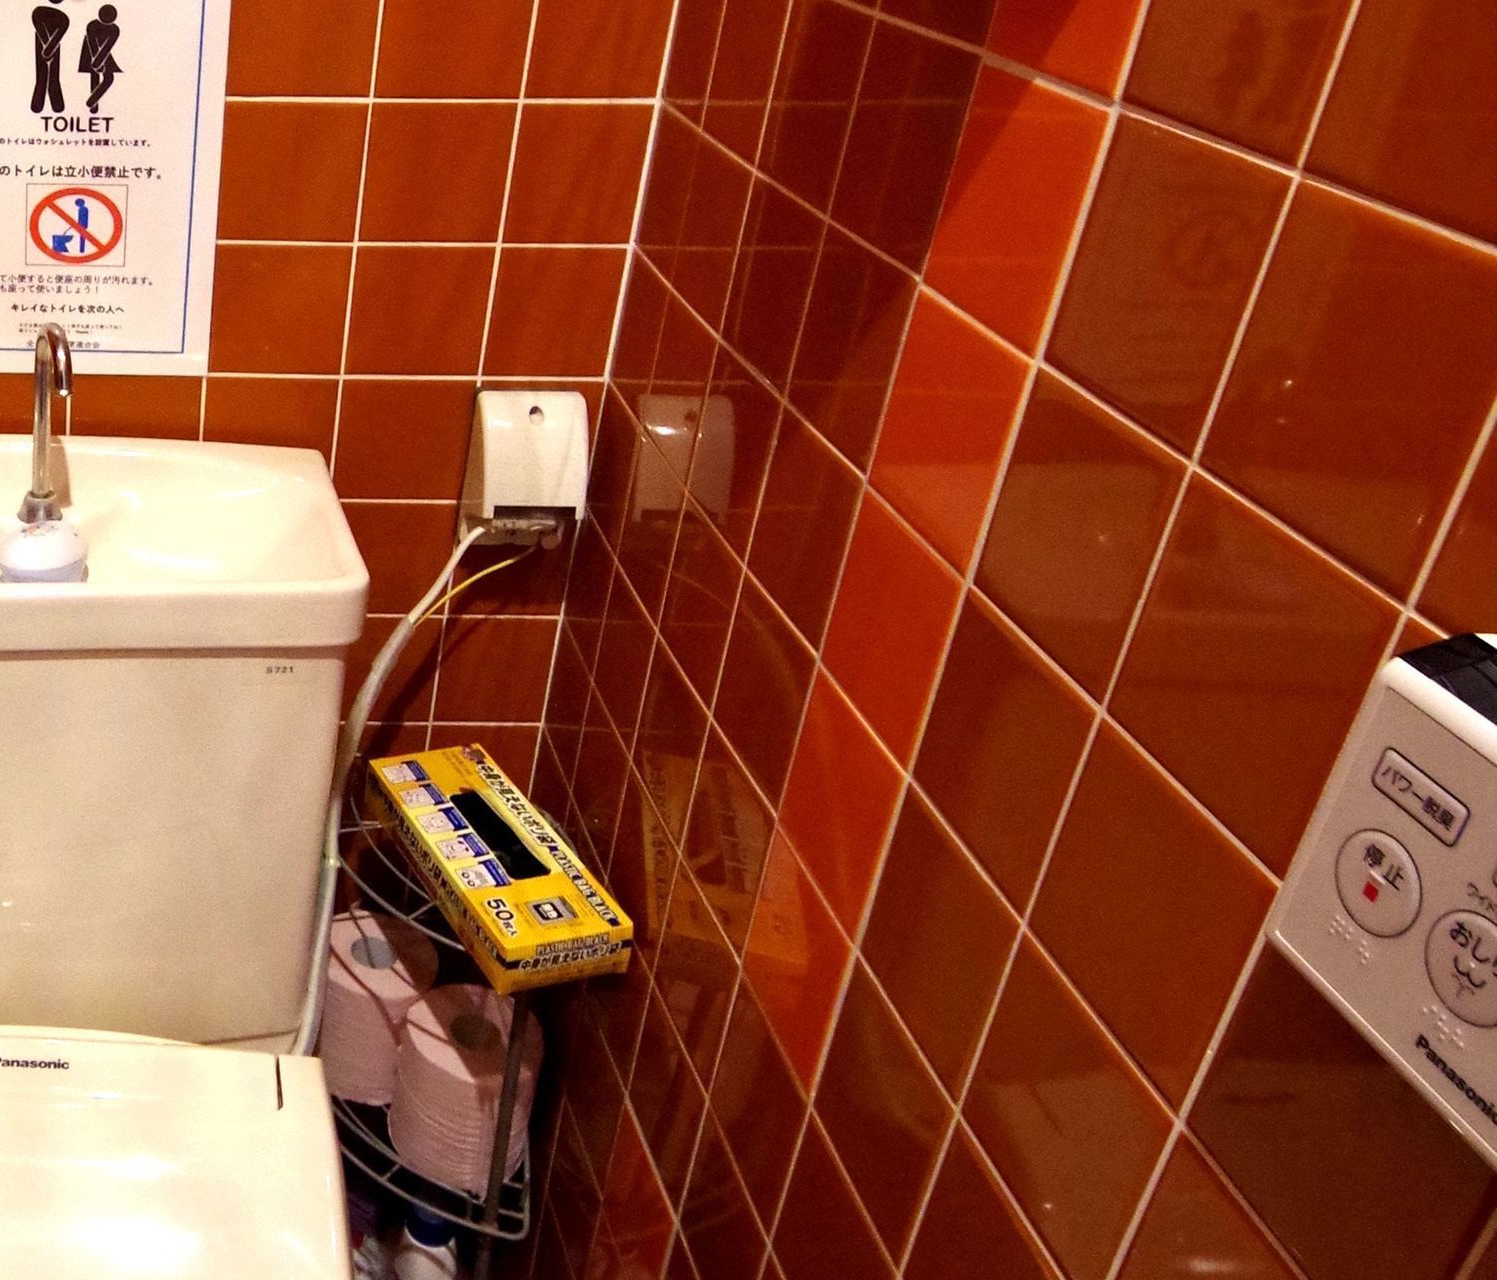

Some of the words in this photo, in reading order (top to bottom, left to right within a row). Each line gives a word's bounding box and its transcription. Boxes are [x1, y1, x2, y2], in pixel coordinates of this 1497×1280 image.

[40, 115, 114, 133] TOILET
[11, 303, 125, 315] キレイなトイレを次の人へ
[1363, 842, 1404, 892] 停止
[1416, 1033, 1497, 1126] Panasoni
